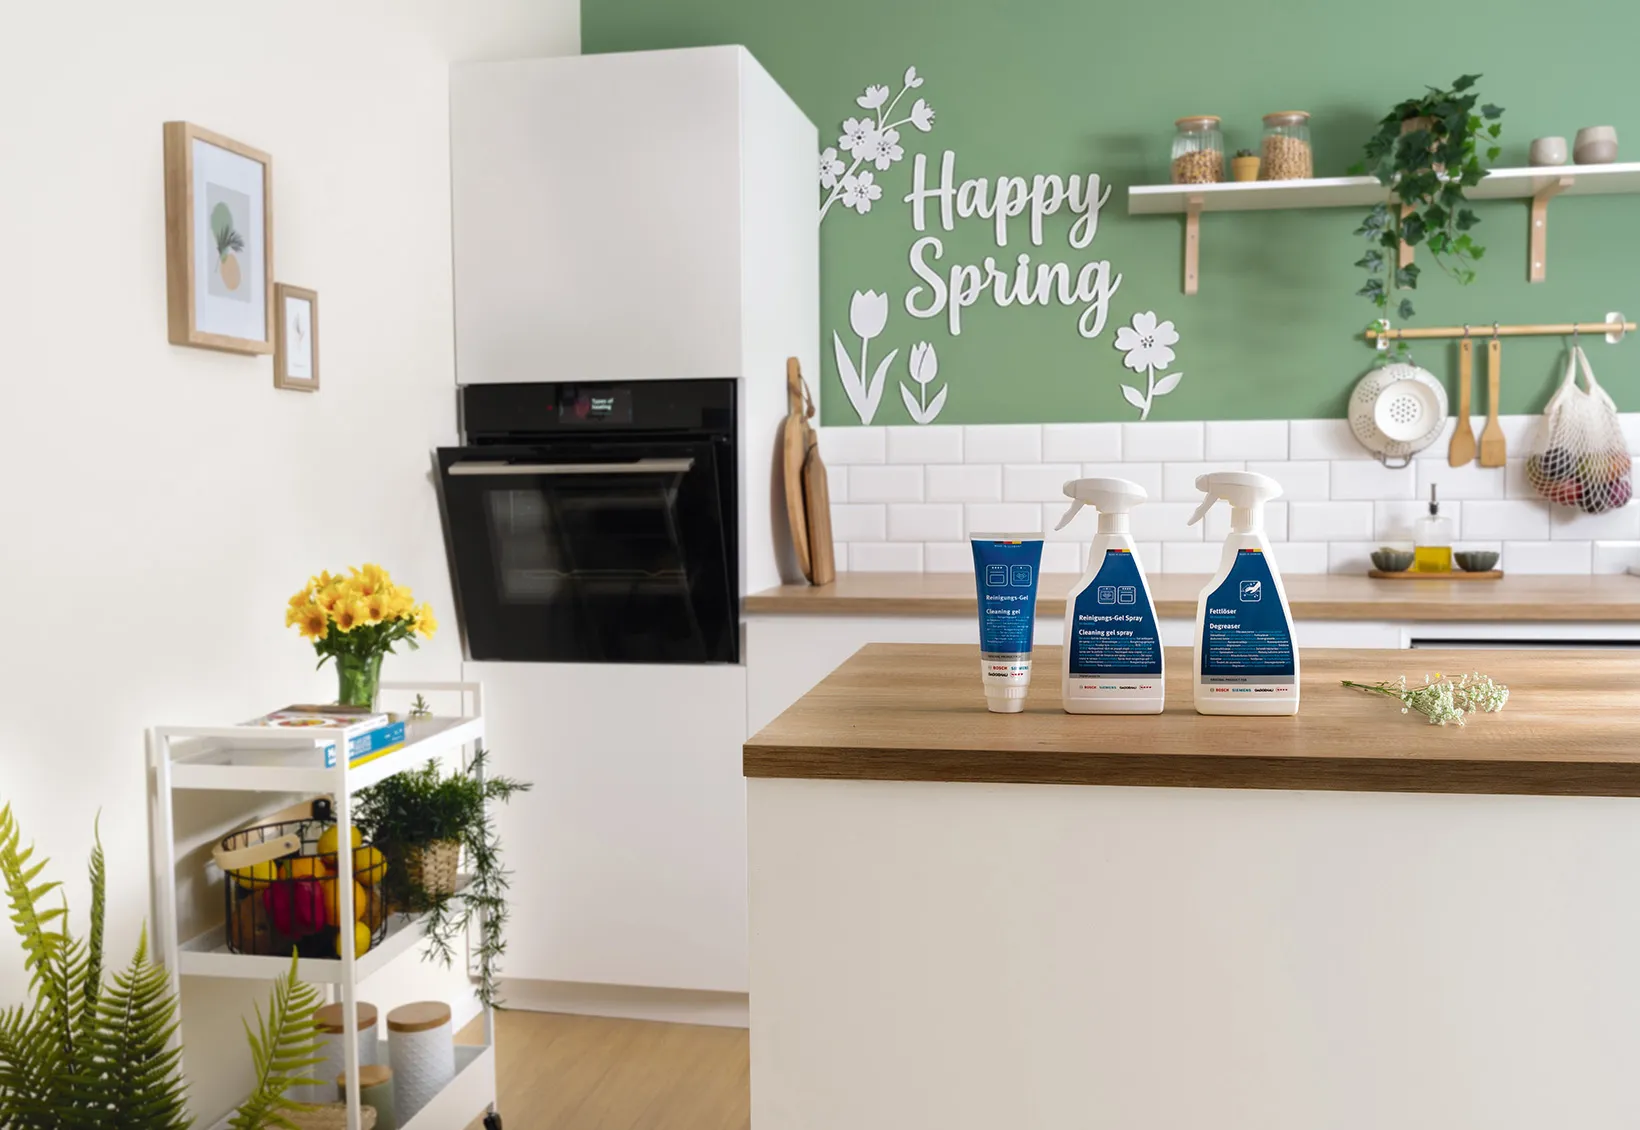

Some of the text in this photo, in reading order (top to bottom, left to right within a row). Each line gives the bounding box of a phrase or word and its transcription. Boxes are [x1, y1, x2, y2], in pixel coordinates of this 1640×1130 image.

[903, 150, 1112, 249] Happy
[904, 236, 1123, 338] Spring
[986, 594, 1029, 602] Reinigungs-Gel
[986, 608, 1021, 616] Cleaning gel
[1079, 614, 1143, 622] Reinigungs-Gel Spray
